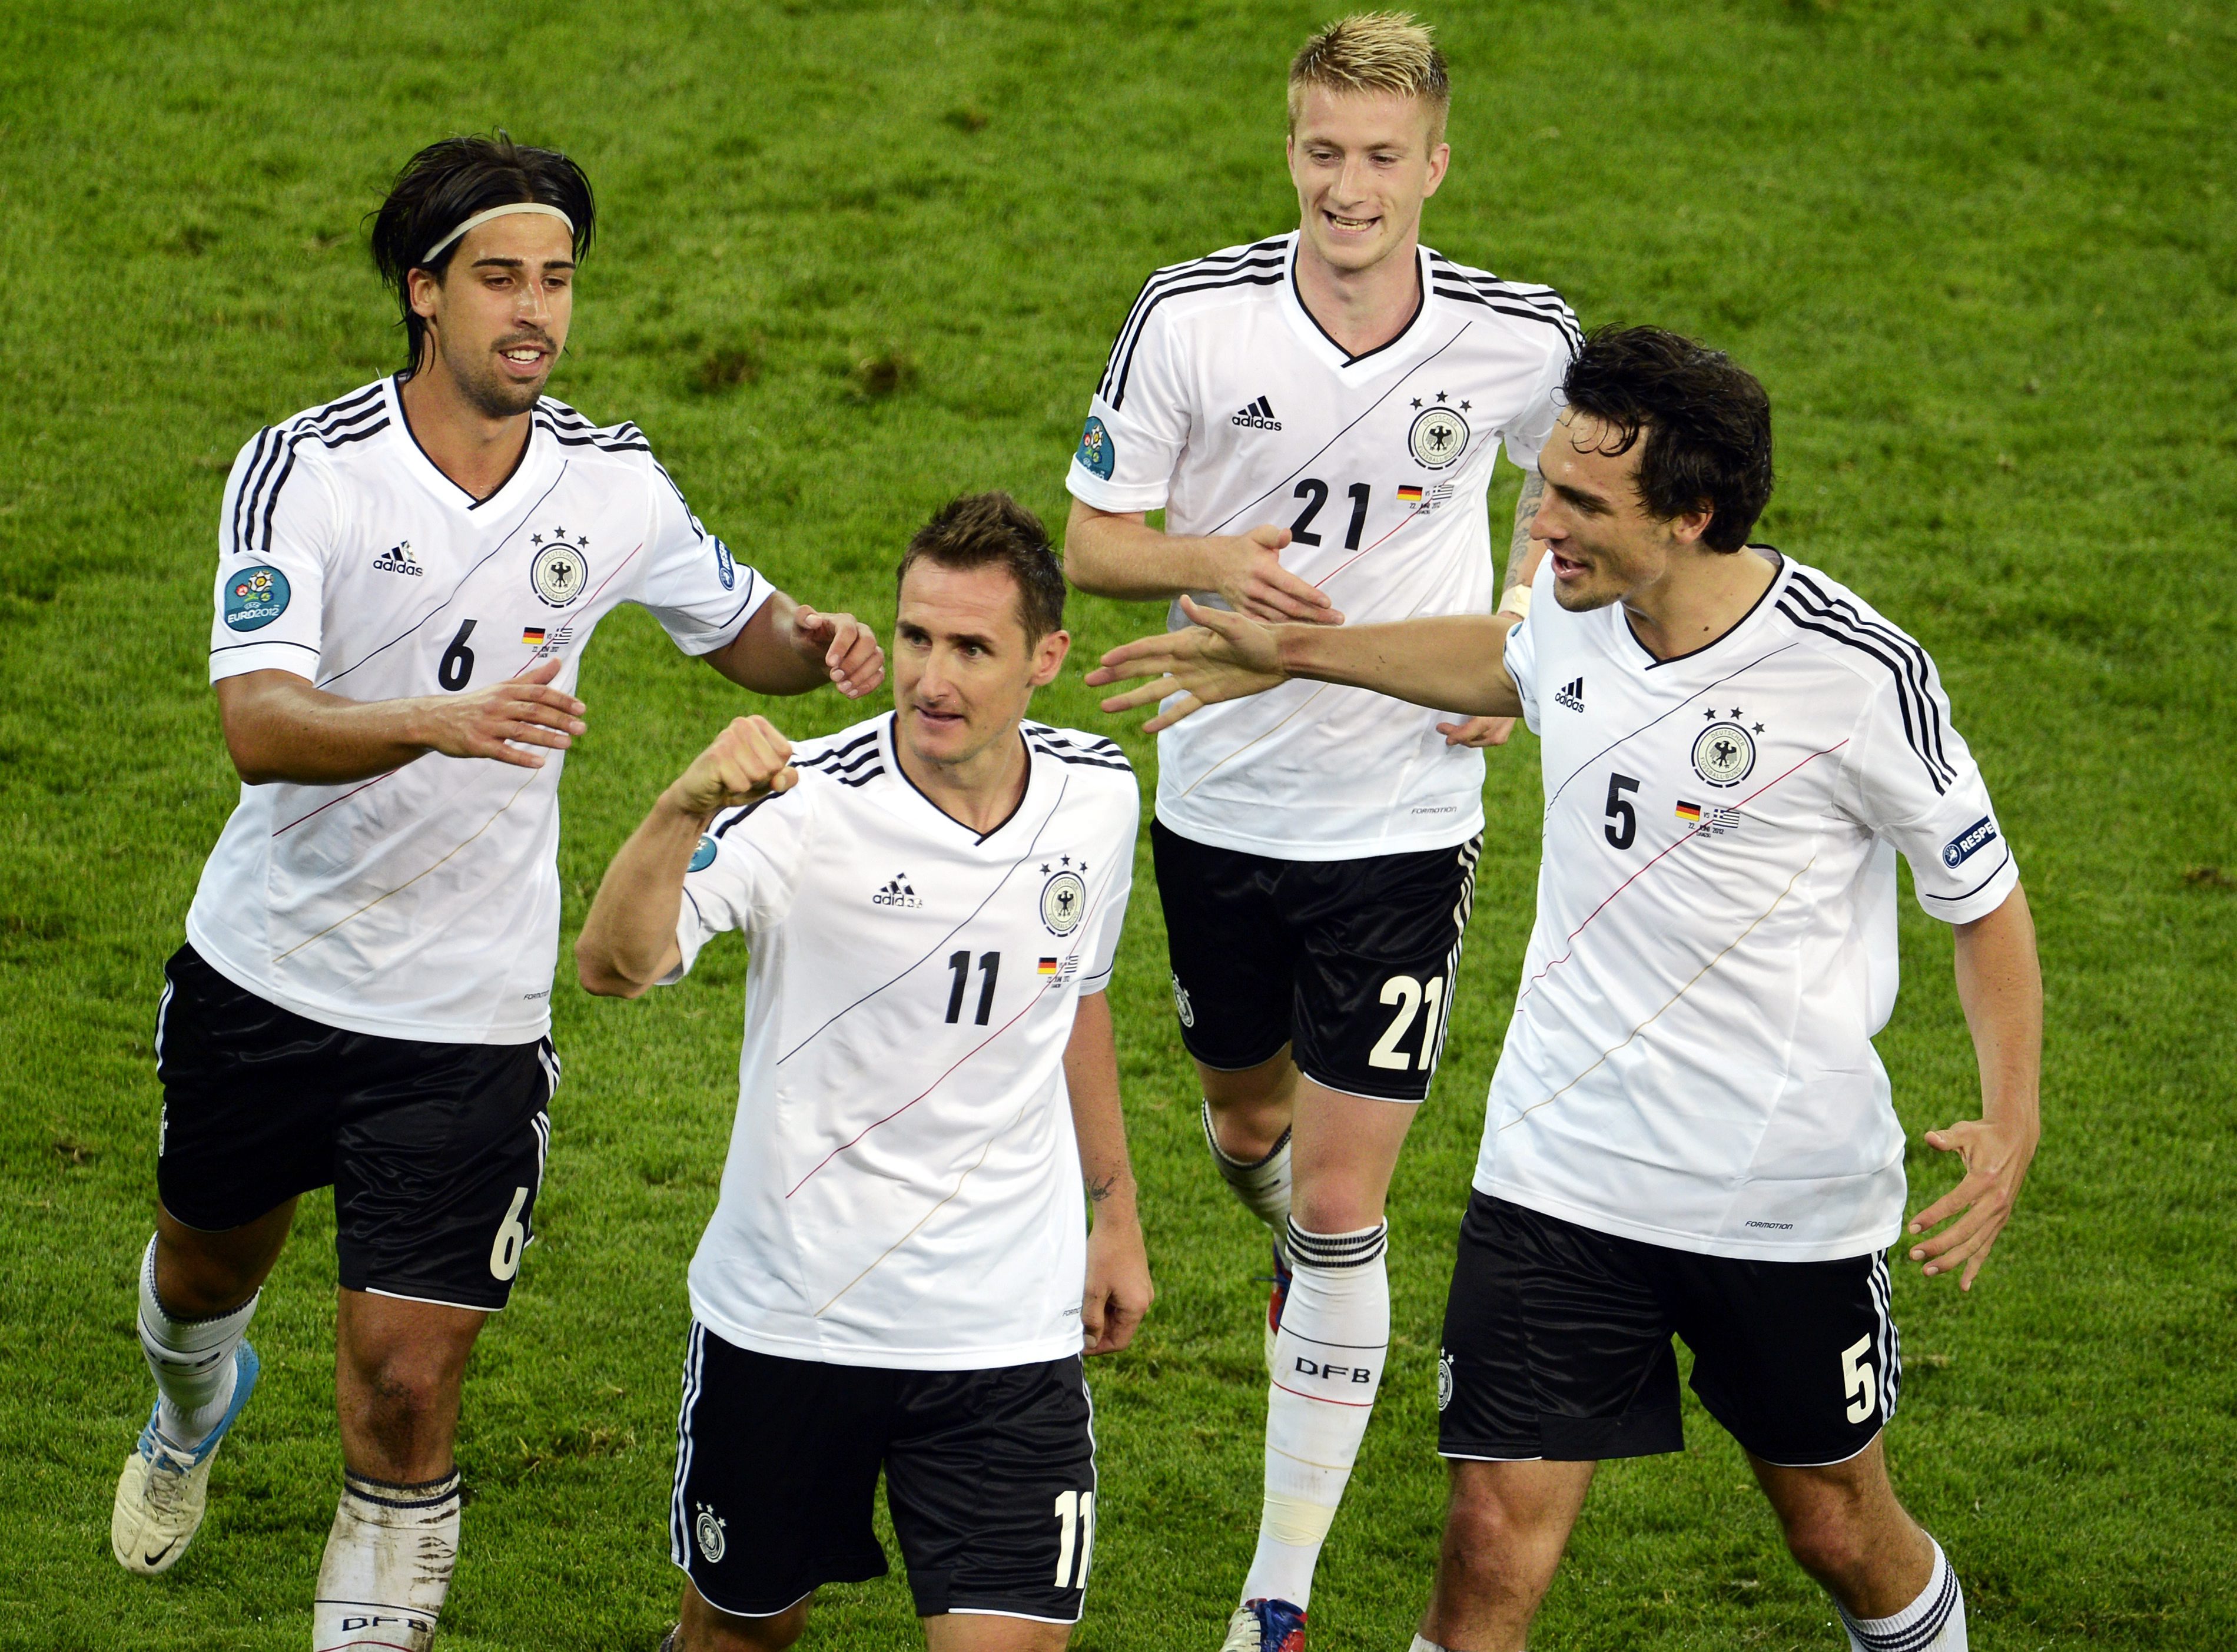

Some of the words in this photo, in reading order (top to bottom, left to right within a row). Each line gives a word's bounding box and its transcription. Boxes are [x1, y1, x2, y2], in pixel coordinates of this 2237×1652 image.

[1232, 416, 1282, 431] adidas
[1423, 414, 1458, 427] DEUTSCHER
[1290, 478, 1370, 551] 21
[373, 559, 423, 576] adidas
[544, 550, 577, 564] DEUTSCHER
[228, 608, 280, 623] EURO2012
[438, 619, 477, 691] 6
[1555, 692, 1585, 713] adidas
[1711, 730, 1745, 747] DEUTSCHER
[1412, 806, 1458, 814] FORMOTION
[1605, 772, 1640, 850] 5
[1959, 821, 1995, 852] RESPE
[944, 950, 1001, 1026] 11
[1368, 975, 1443, 1070] 21
[490, 1186, 529, 1281] 6
[1745, 1221, 1793, 1229] FORMOTION
[1296, 1357, 1370, 1383] DFB
[1841, 1332, 1876, 1424] 5
[1054, 1490, 1093, 1589] 11
